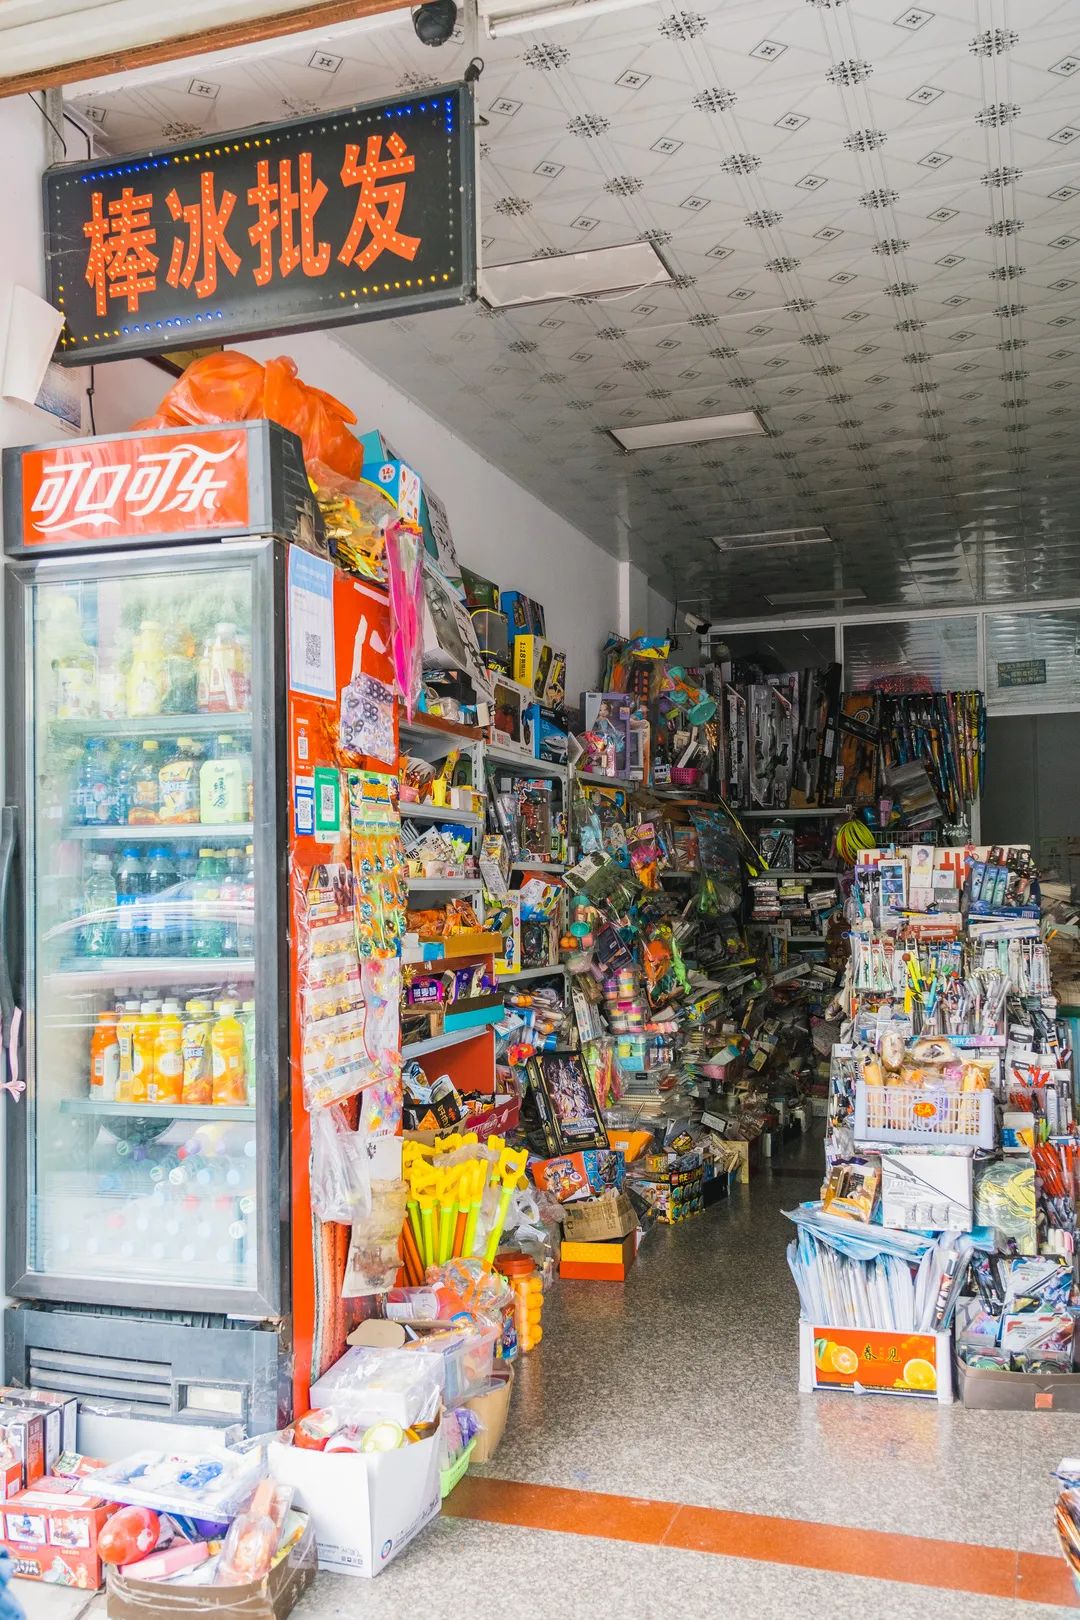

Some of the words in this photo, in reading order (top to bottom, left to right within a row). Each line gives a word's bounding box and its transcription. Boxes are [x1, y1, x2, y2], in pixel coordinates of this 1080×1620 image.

[83, 132, 421, 316] 棒冰批发
[31, 440, 240, 532] 可口可乐
[863, 1344, 902, 1363] 春见
